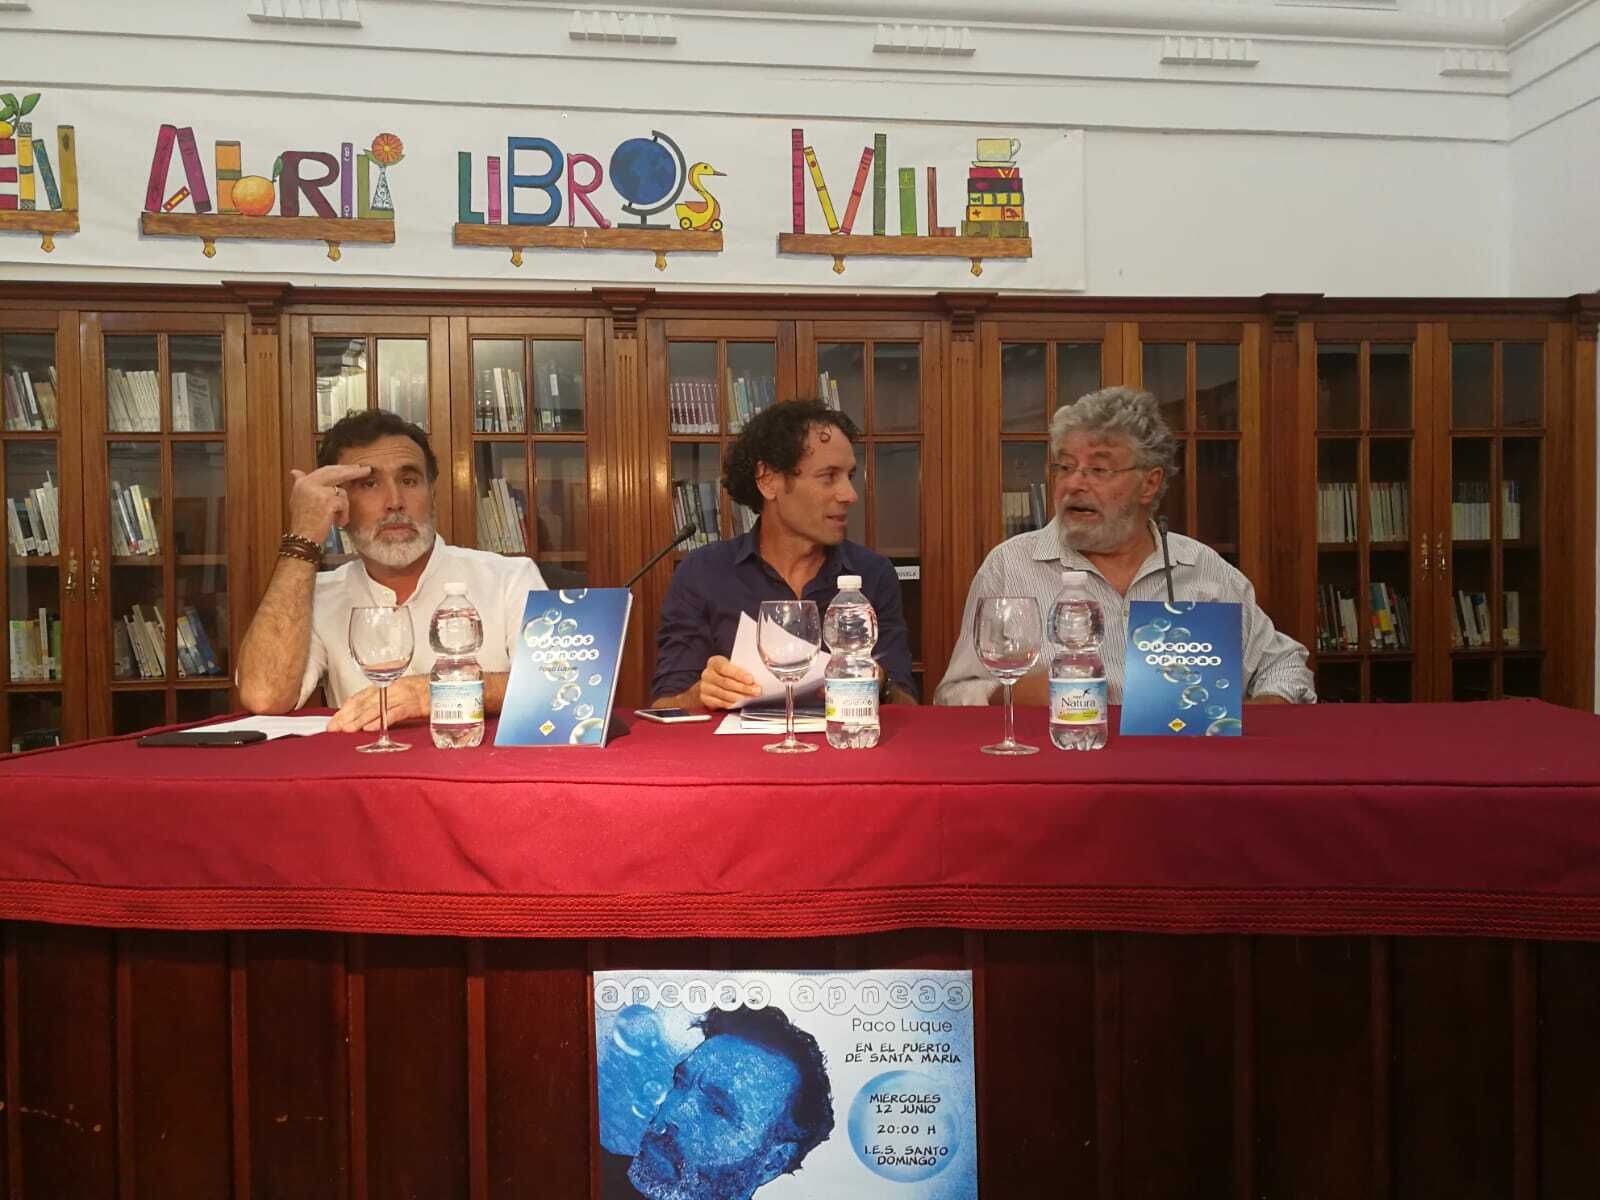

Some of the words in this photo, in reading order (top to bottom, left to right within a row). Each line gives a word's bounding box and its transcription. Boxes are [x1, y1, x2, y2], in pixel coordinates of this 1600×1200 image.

[144, 124, 395, 220] ABRIL
[458, 130, 726, 231] LIBROS
[1138, 642, 1212, 652] apenas
[1146, 655, 1221, 665] apneas
[1061, 696, 1096, 707] Natura
[600, 982, 766, 1009] apenas
[794, 983, 968, 1012] apneas
[852, 1017, 896, 1033] Paco
[901, 1017, 953, 1035] Luque
[855, 1042, 873, 1053] EN
[880, 1042, 895, 1053] EL
[902, 1042, 951, 1053] PUERTO
[845, 1053, 862, 1063] DE
[869, 1053, 913, 1064] SANTA
[876, 1104, 892, 1114] 12
[900, 1104, 936, 1114] JUNIO
[877, 1124, 919, 1135] 20:00
[927, 1124, 936, 1135] H
[864, 1145, 896, 1155] I.E.S.
[904, 1145, 949, 1156] SANTO
[877, 1155, 937, 1166] DOMINGO
